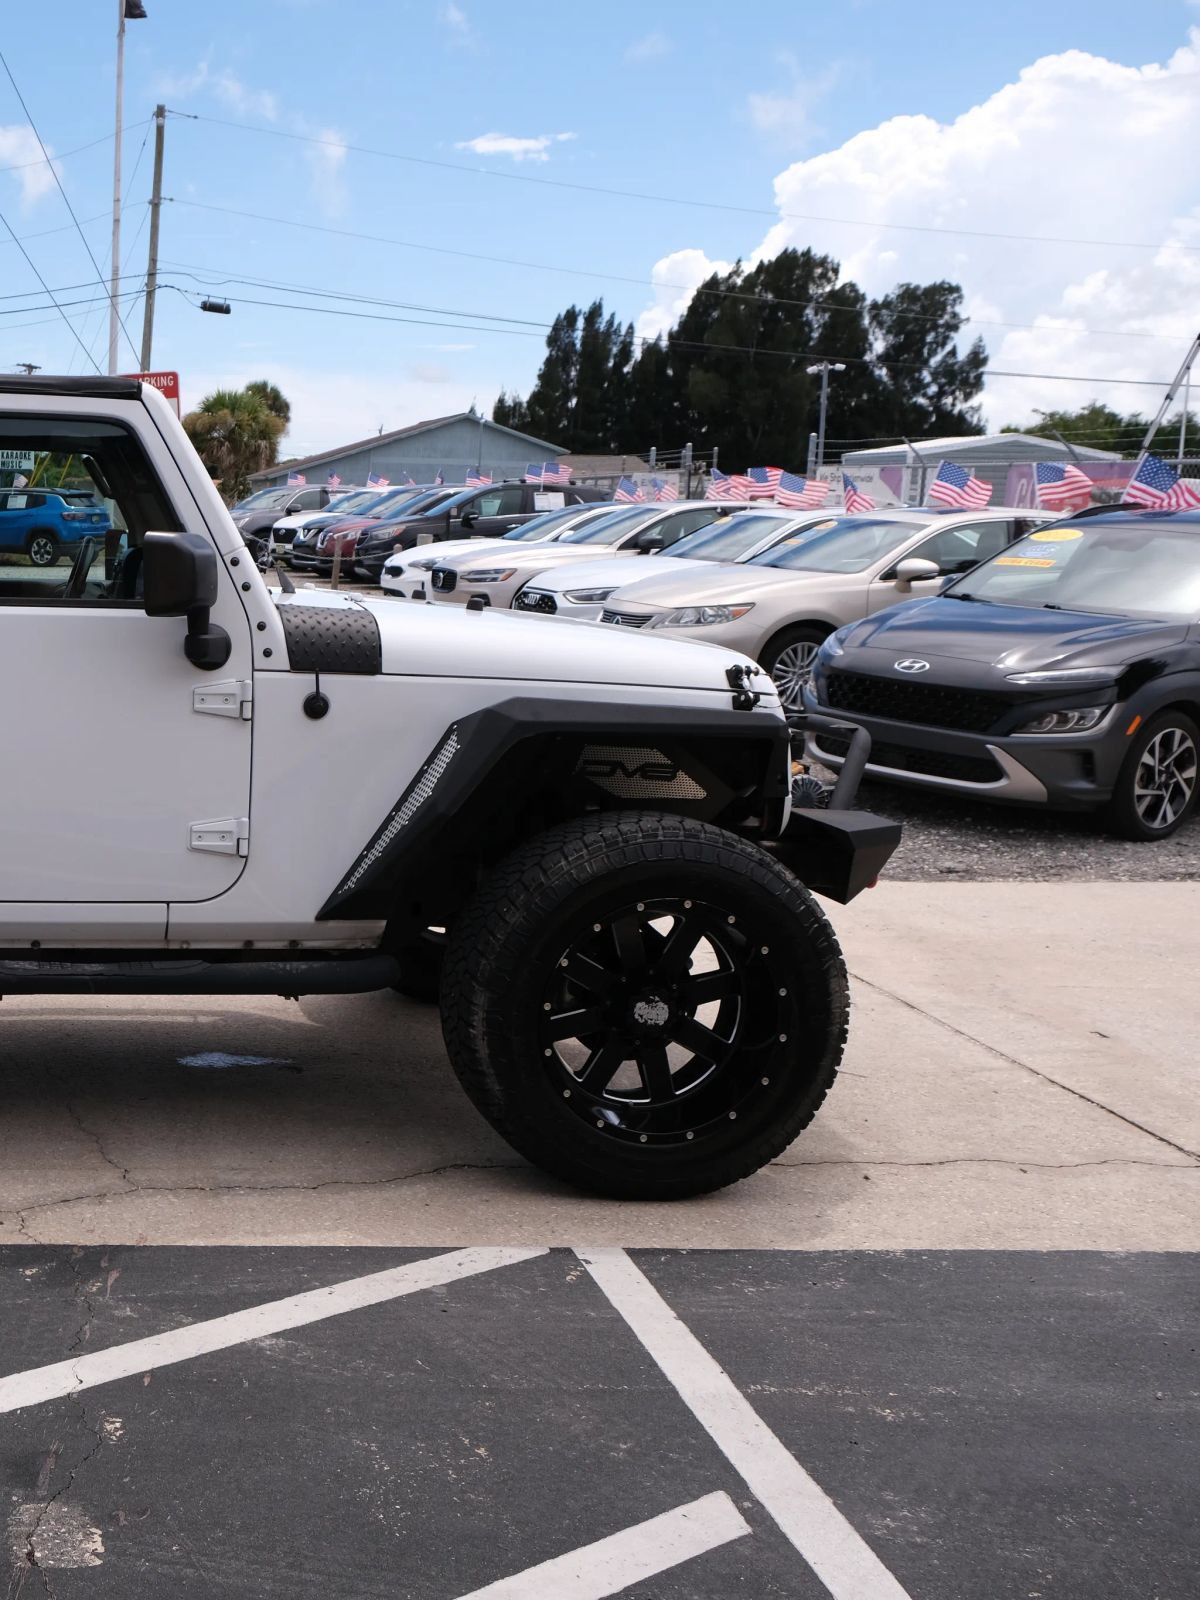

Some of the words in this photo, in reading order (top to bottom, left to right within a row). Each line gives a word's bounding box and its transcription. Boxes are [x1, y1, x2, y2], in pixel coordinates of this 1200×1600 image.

[138, 375, 174, 387] RKING
[1, 451, 31, 460] KARAOKE
[0, 461, 23, 470] MUSIC
